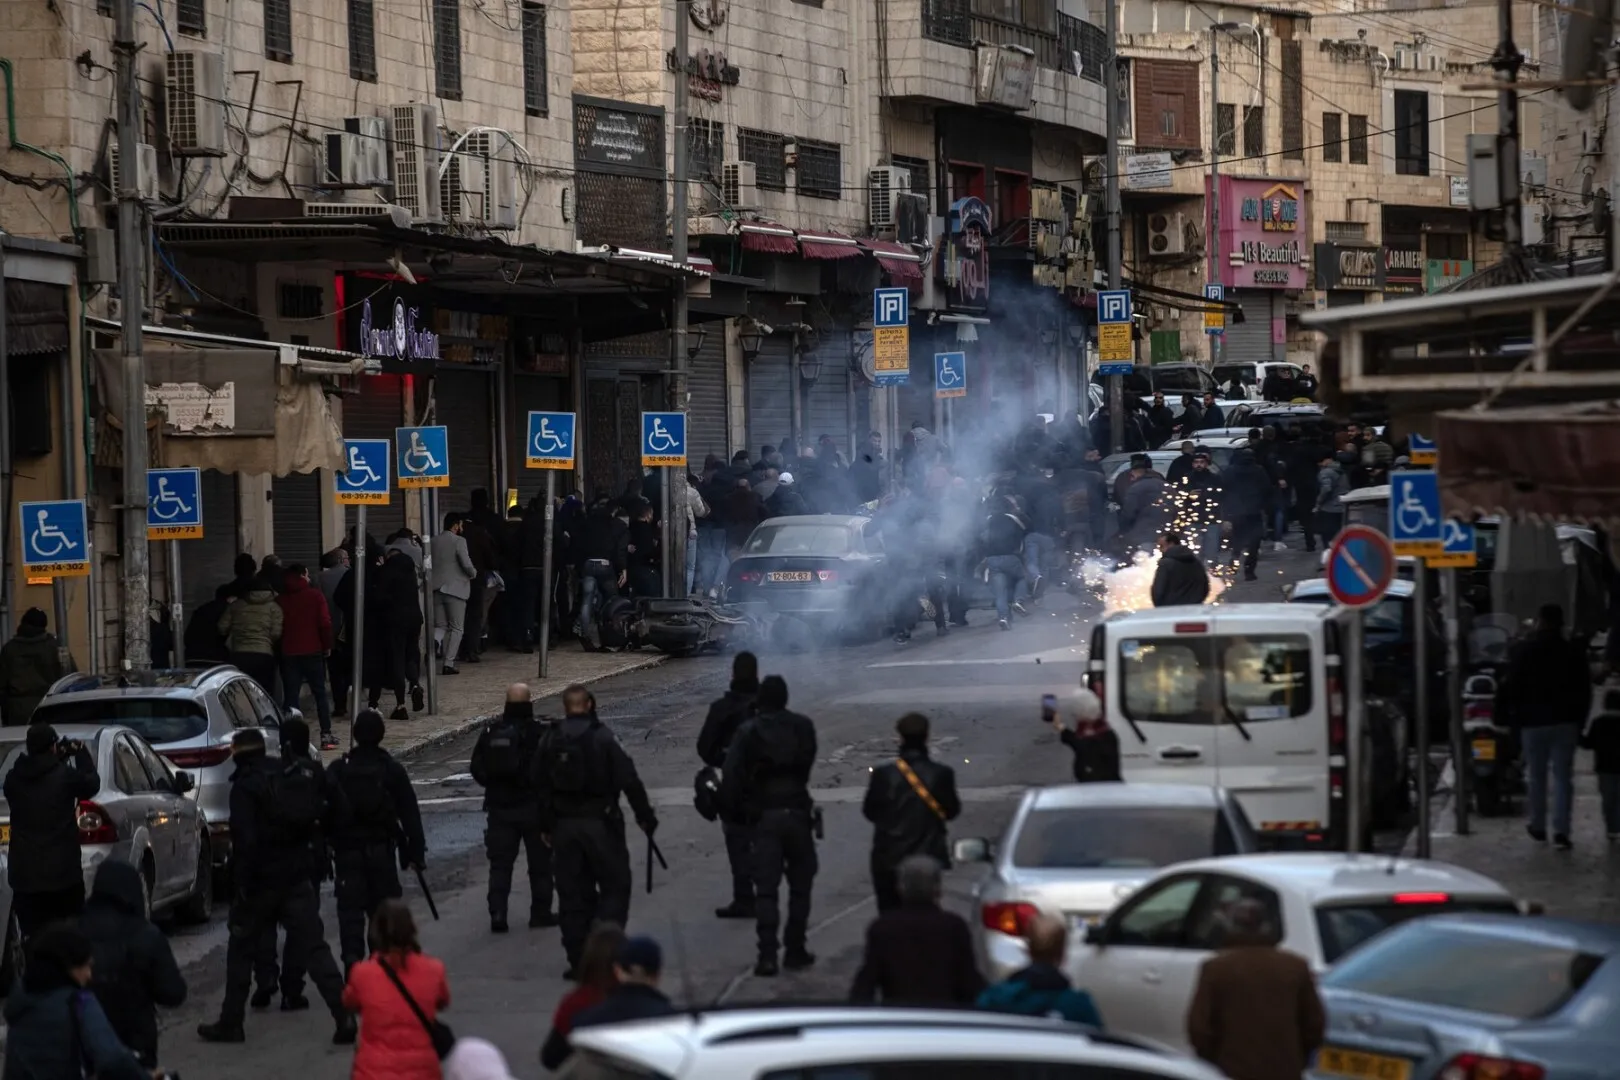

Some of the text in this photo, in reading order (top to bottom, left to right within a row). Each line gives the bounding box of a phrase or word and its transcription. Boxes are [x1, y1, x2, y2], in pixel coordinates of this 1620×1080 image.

[1243, 240, 1300, 264] It's Beautiful
[889, 360, 895, 369] 3
[30, 563, 85, 572] 892-14-302
